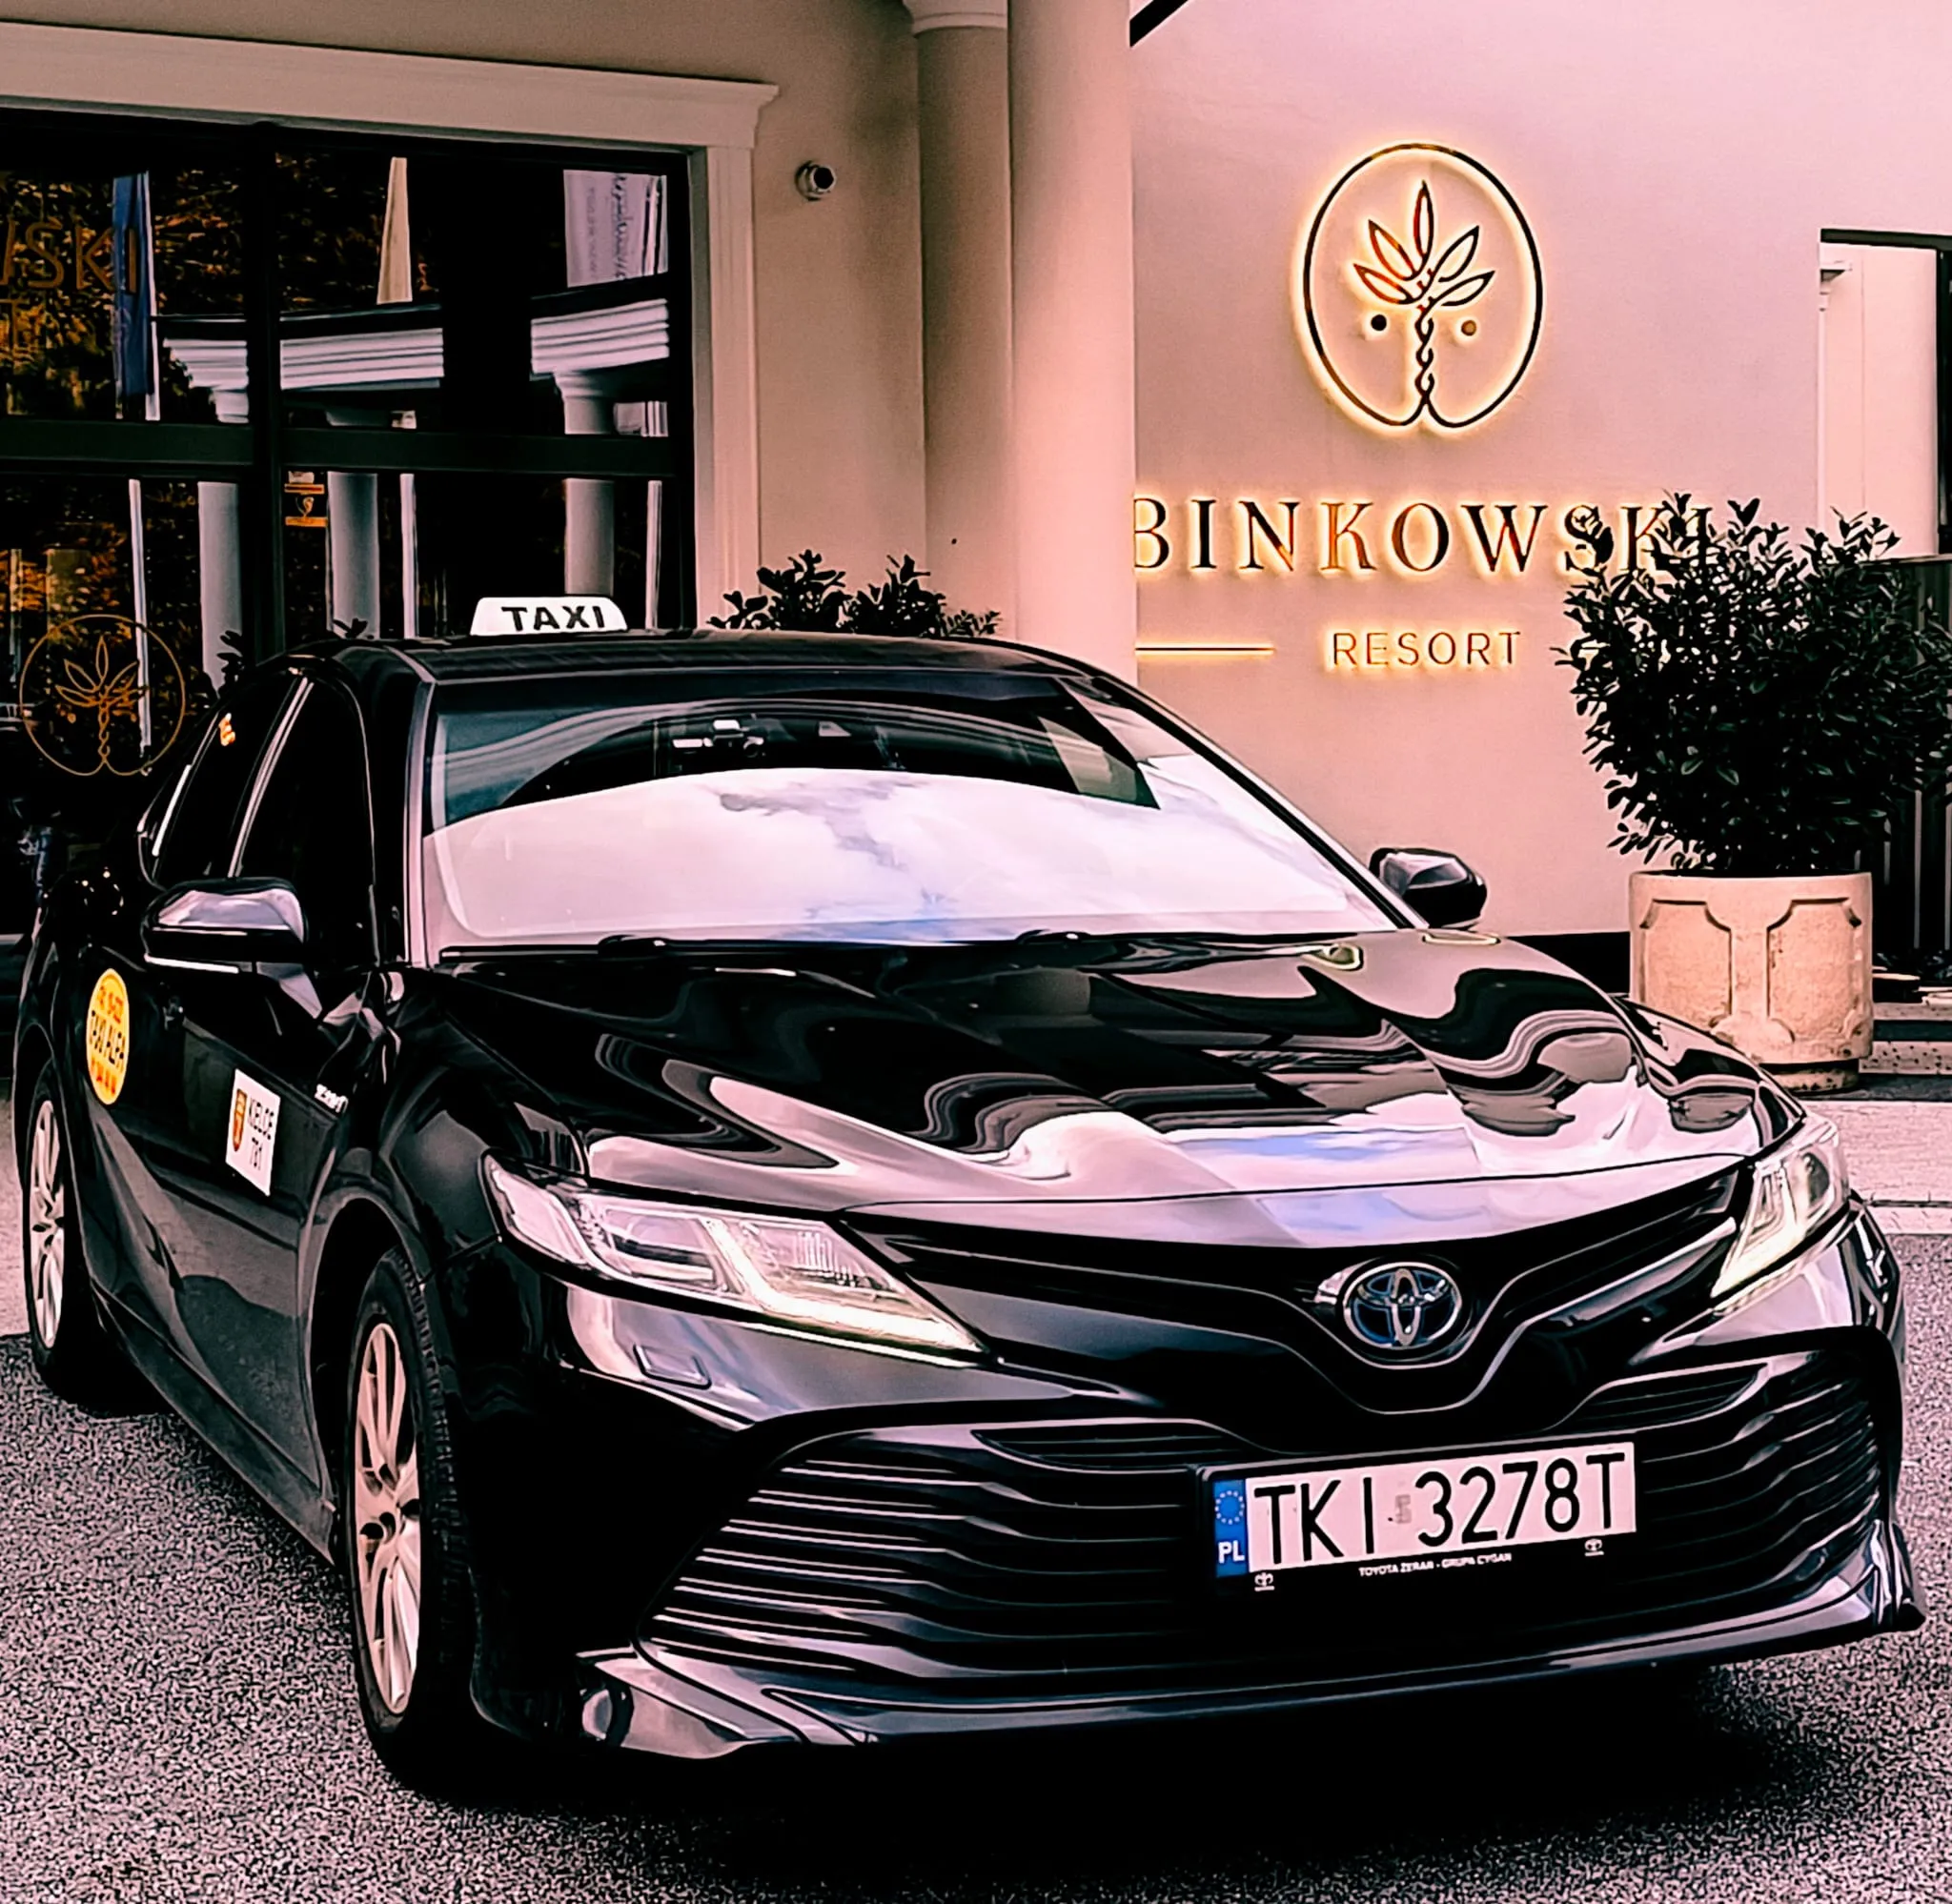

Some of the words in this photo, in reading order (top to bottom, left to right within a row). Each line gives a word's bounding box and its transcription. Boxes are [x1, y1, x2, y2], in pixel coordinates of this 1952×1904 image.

[1133, 497, 1713, 574] BINKOWSKI
[500, 606, 605, 631] TAXI
[1333, 631, 1520, 666] RESORT
[1253, 1476, 1374, 1565] TKI
[1414, 1452, 1626, 1548] 3278T
[1218, 1540, 1245, 1564] PL
[1358, 1564, 1399, 1577] TOYOTA
